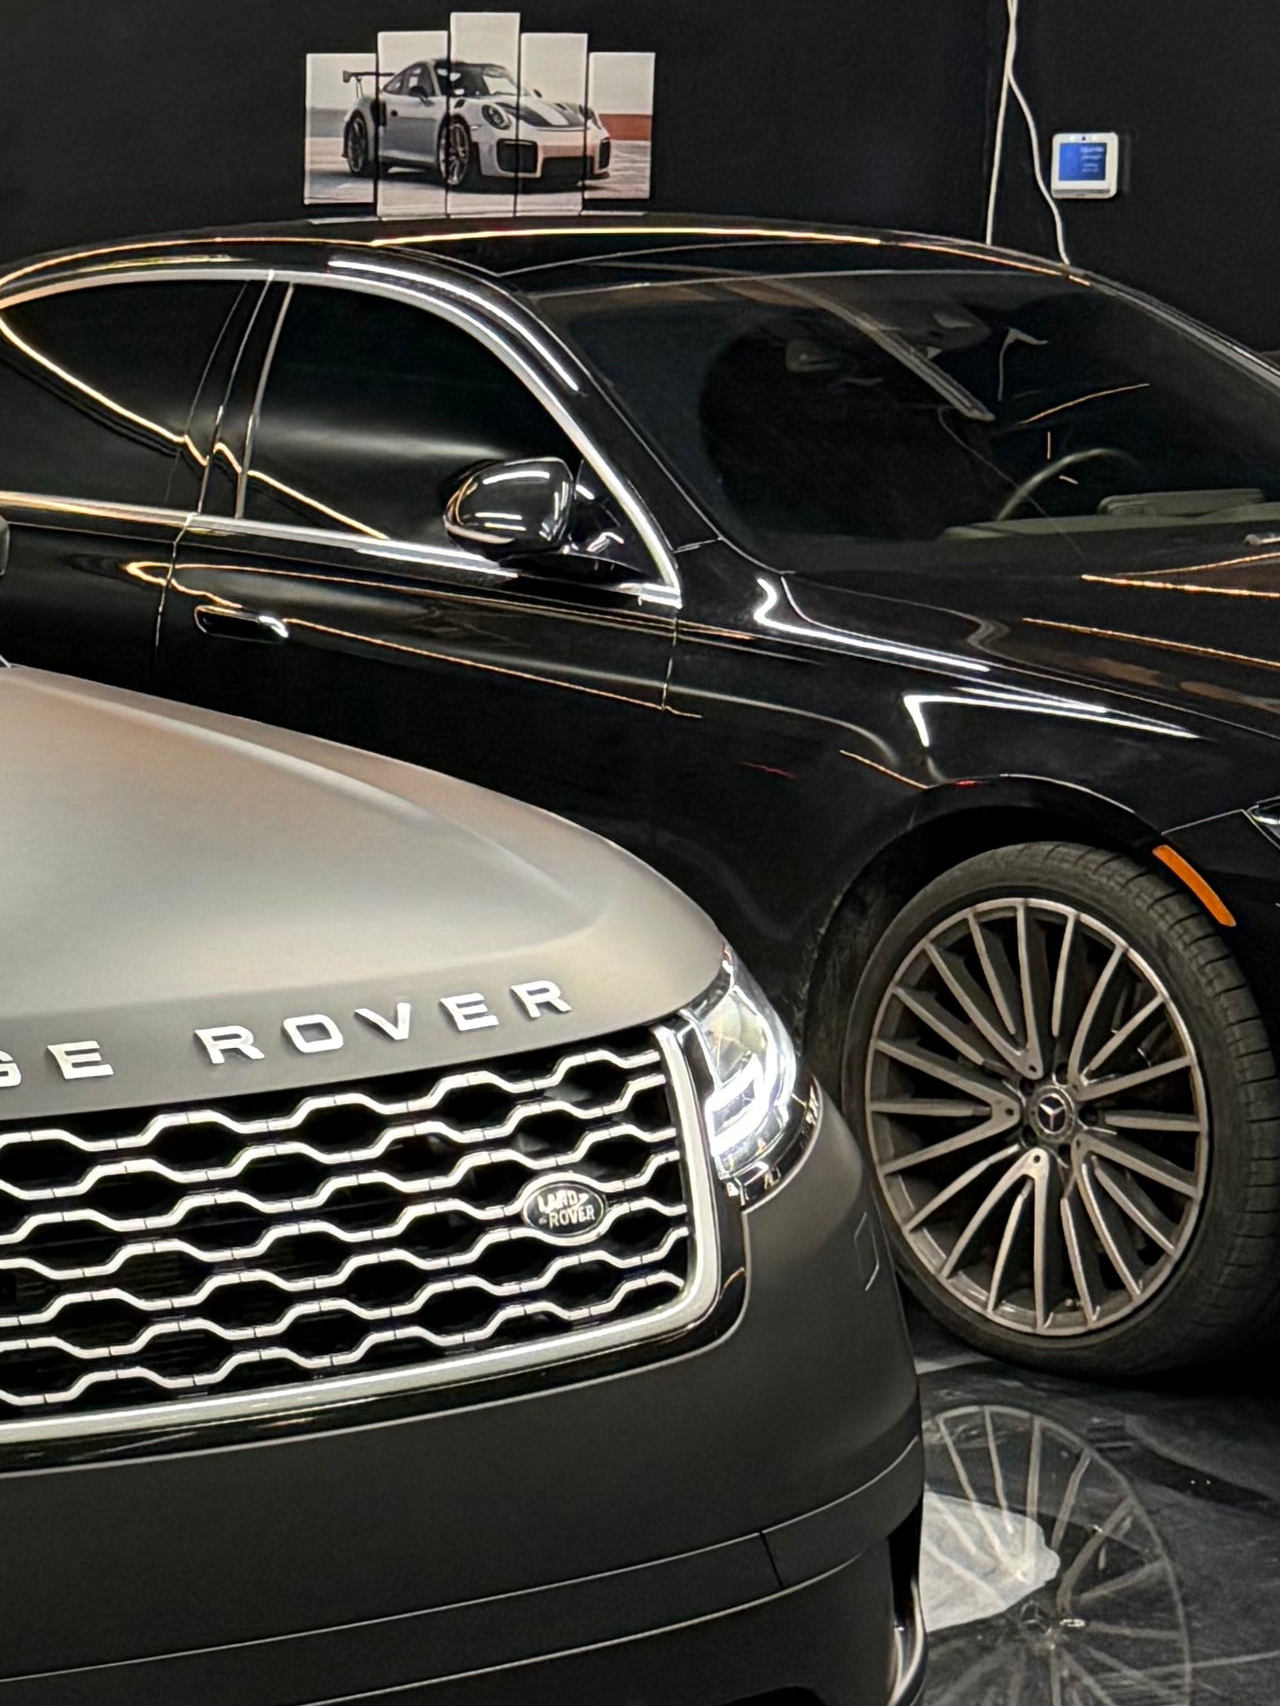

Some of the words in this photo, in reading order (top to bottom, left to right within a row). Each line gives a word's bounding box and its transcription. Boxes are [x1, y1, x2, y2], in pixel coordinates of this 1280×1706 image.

[194, 979, 573, 1066] ROVER
[536, 1189, 578, 1213] LAND
[548, 1204, 595, 1229] ROVER
